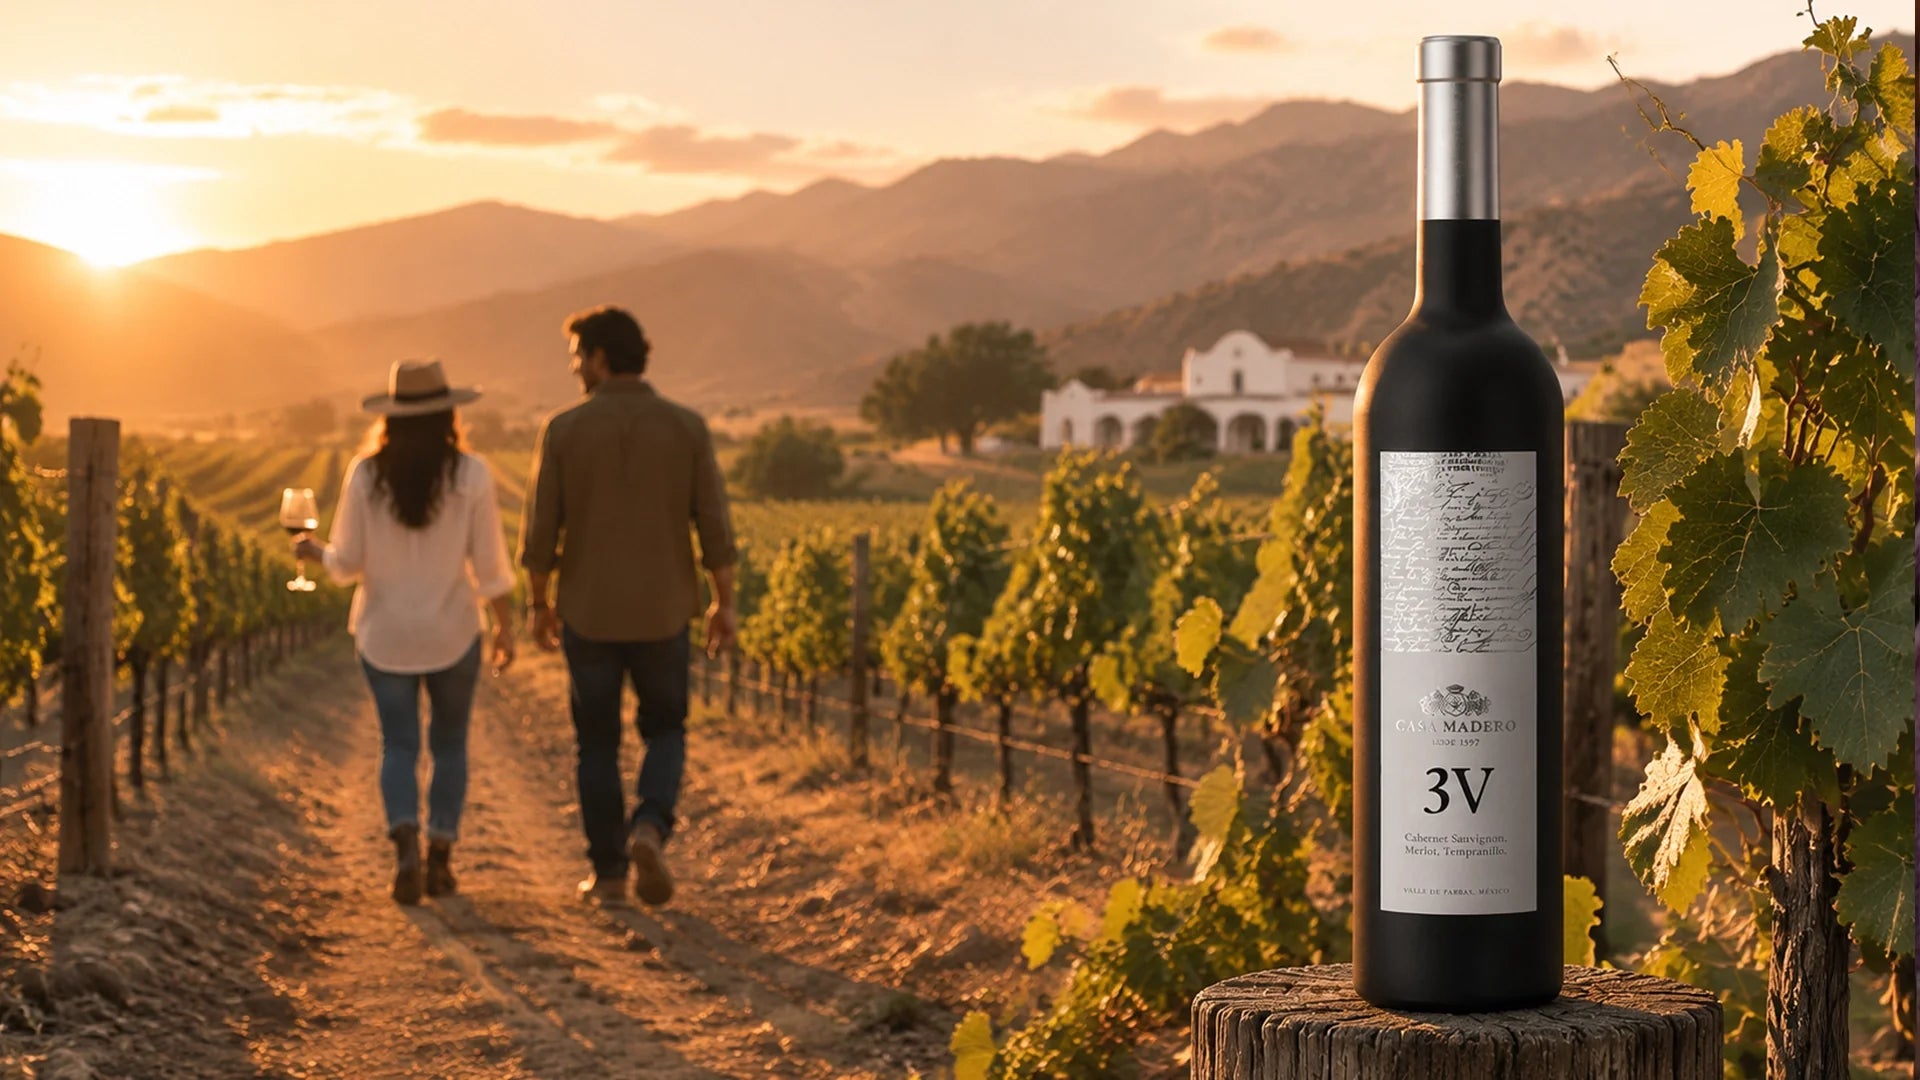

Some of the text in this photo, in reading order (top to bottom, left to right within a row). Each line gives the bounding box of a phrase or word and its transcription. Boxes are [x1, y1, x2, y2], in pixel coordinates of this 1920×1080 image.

[1395, 719, 1516, 733] CASA MADERO
[1423, 767, 1495, 815] 3V
[1404, 832, 1449, 843] Cabernet
